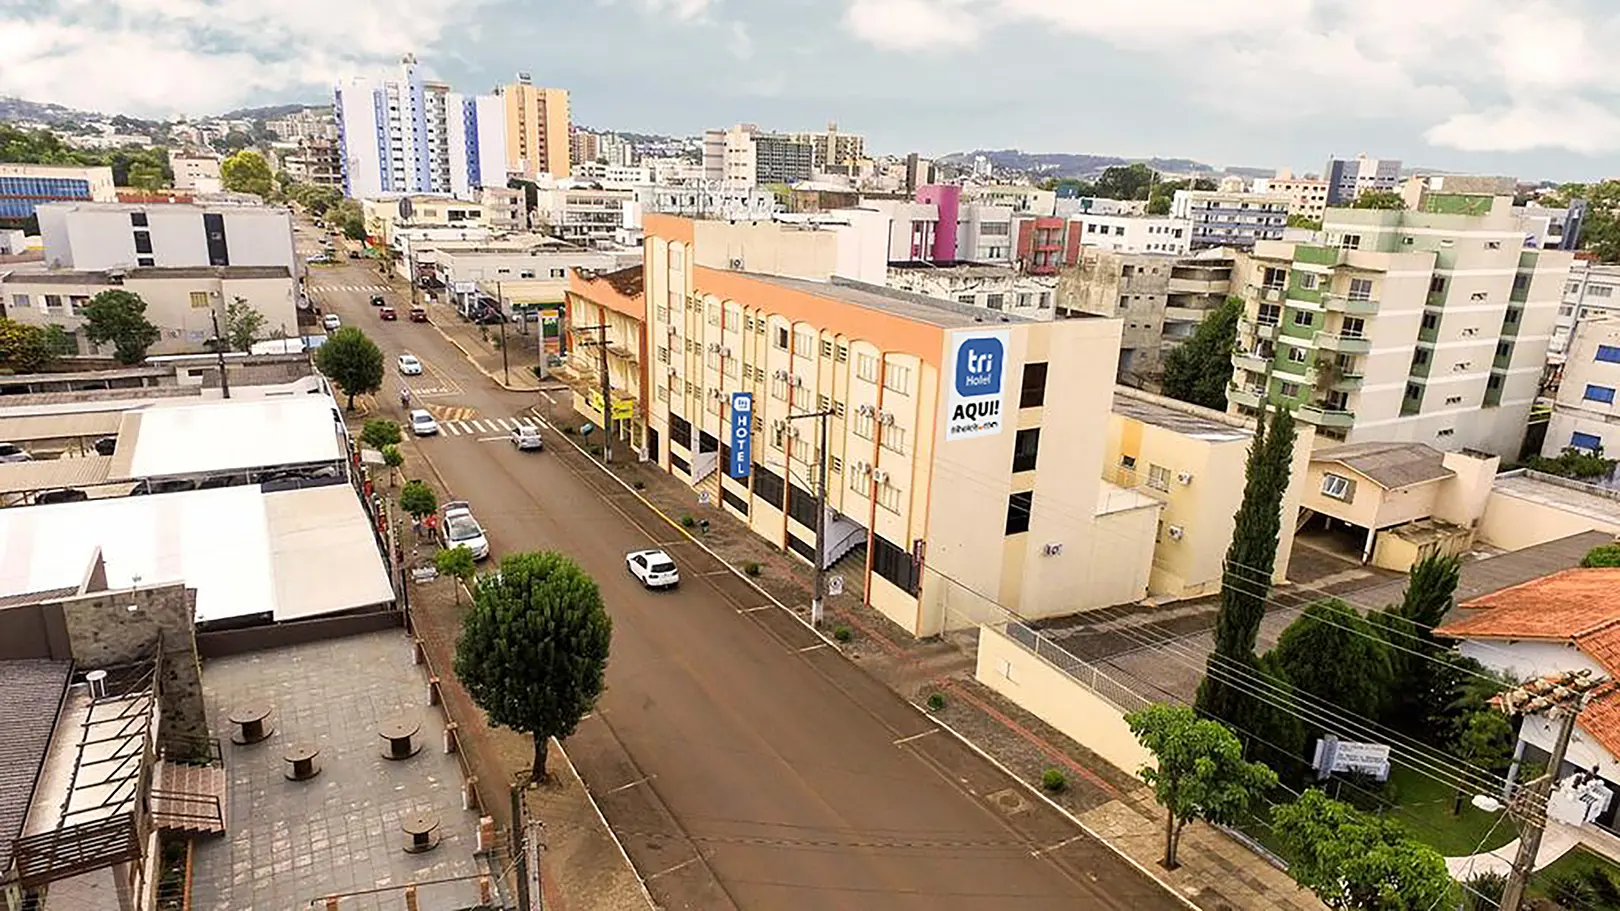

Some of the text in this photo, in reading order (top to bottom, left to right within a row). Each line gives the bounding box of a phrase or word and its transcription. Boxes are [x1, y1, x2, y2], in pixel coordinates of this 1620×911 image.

[968, 349, 993, 373] tri
[965, 374, 992, 386] Hotel
[952, 400, 999, 421] AQUI!
[736, 416, 748, 474] HOTEL
